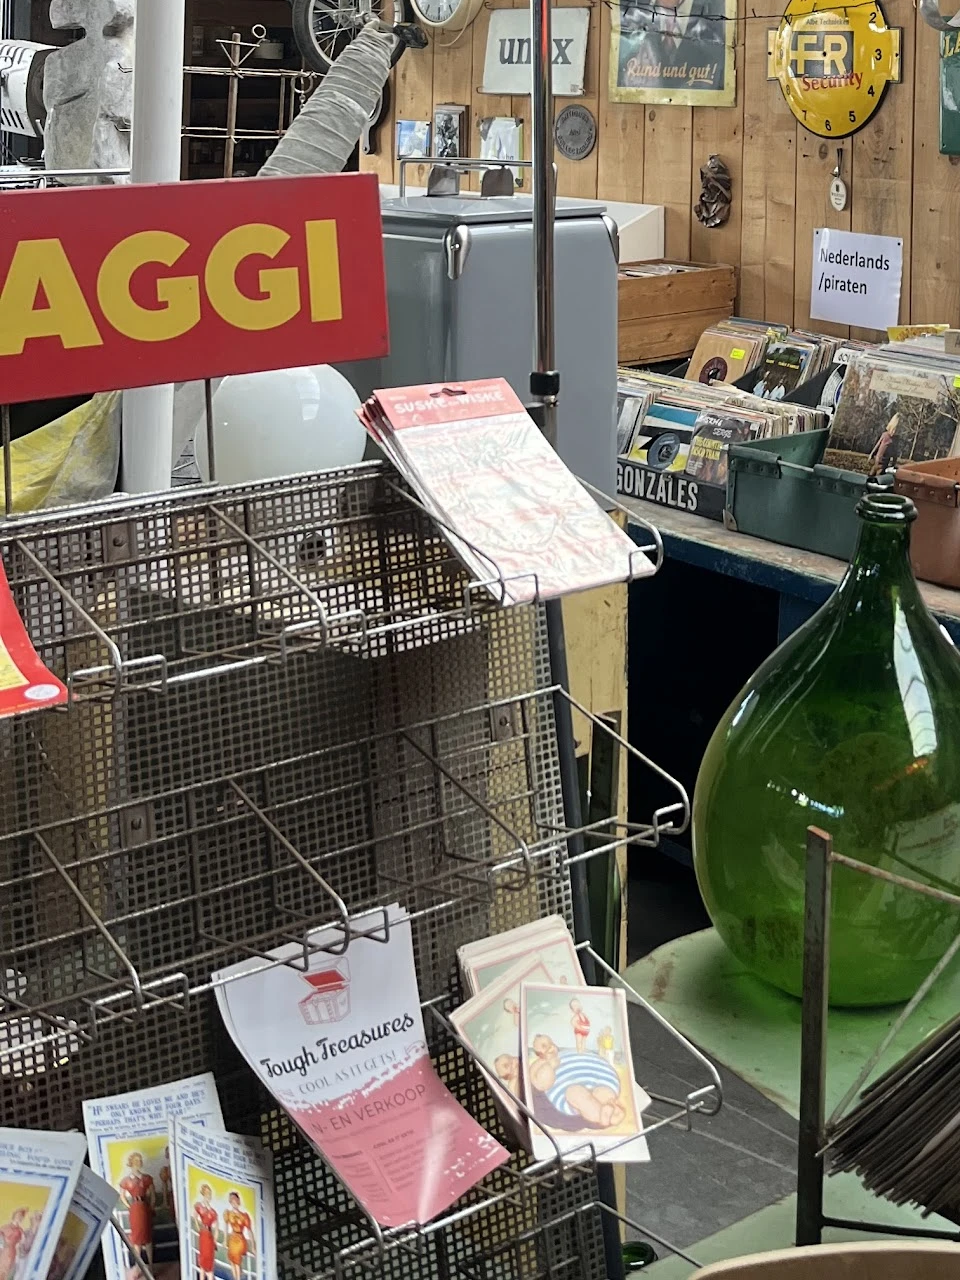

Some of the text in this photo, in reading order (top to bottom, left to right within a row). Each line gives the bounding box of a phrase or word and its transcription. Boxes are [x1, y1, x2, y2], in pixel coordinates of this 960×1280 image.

[869, 12, 876, 24] 2
[499, 37, 574, 65] unx
[875, 48, 882, 61] 3
[626, 57, 717, 86] Rund und gut!
[802, 71, 863, 91] Security
[868, 85, 875, 97] 4
[802, 109, 807, 121] 7
[825, 120, 831, 131] 6
[849, 111, 856, 122] 5
[820, 248, 890, 271] Nederlands
[818, 272, 867, 295] /piraten
[394, 391, 504, 414] SUSKE WISKE
[616, 462, 698, 511] GONZALES
[260, 1013, 414, 1078] Tough Treasures
[299, 1050, 396, 1095] COOL AS IT GETS!
[329, 1113, 353, 1131] EN
[353, 1084, 426, 1121] VERKOOP
